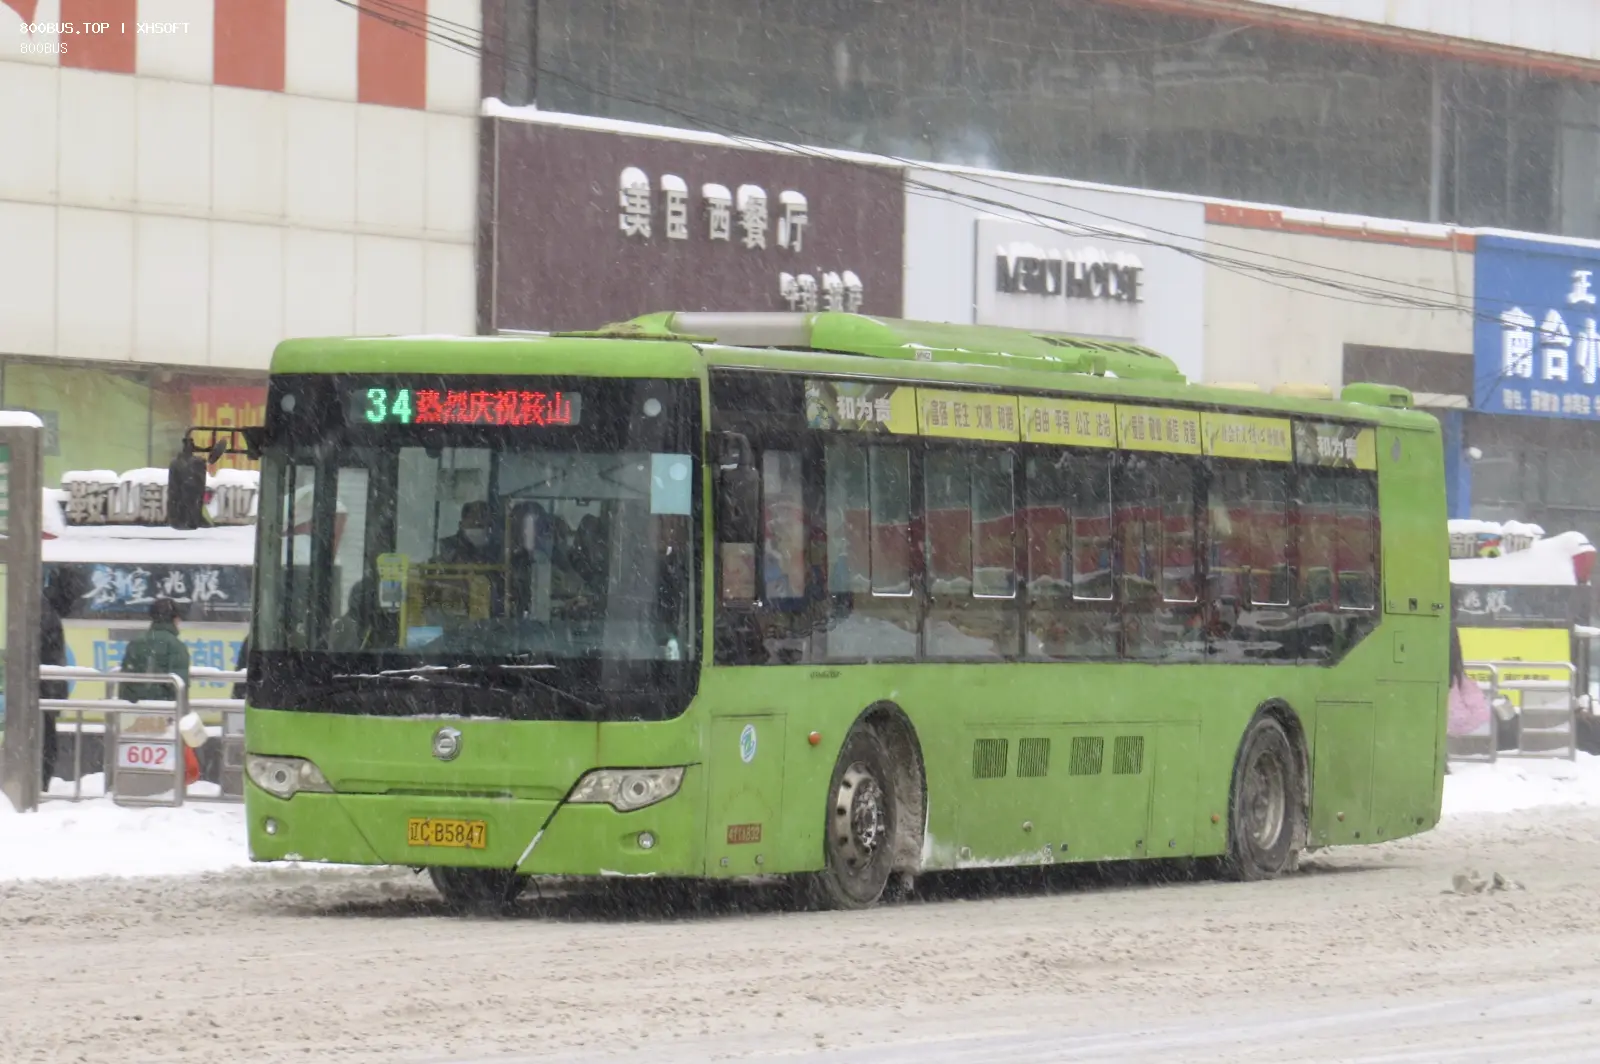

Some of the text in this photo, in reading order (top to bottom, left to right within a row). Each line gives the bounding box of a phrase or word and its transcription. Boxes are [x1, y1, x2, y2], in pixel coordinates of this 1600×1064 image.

[366, 388, 412, 424] 34
[837, 395, 891, 421] 和为贵
[126, 745, 168, 766] 602
